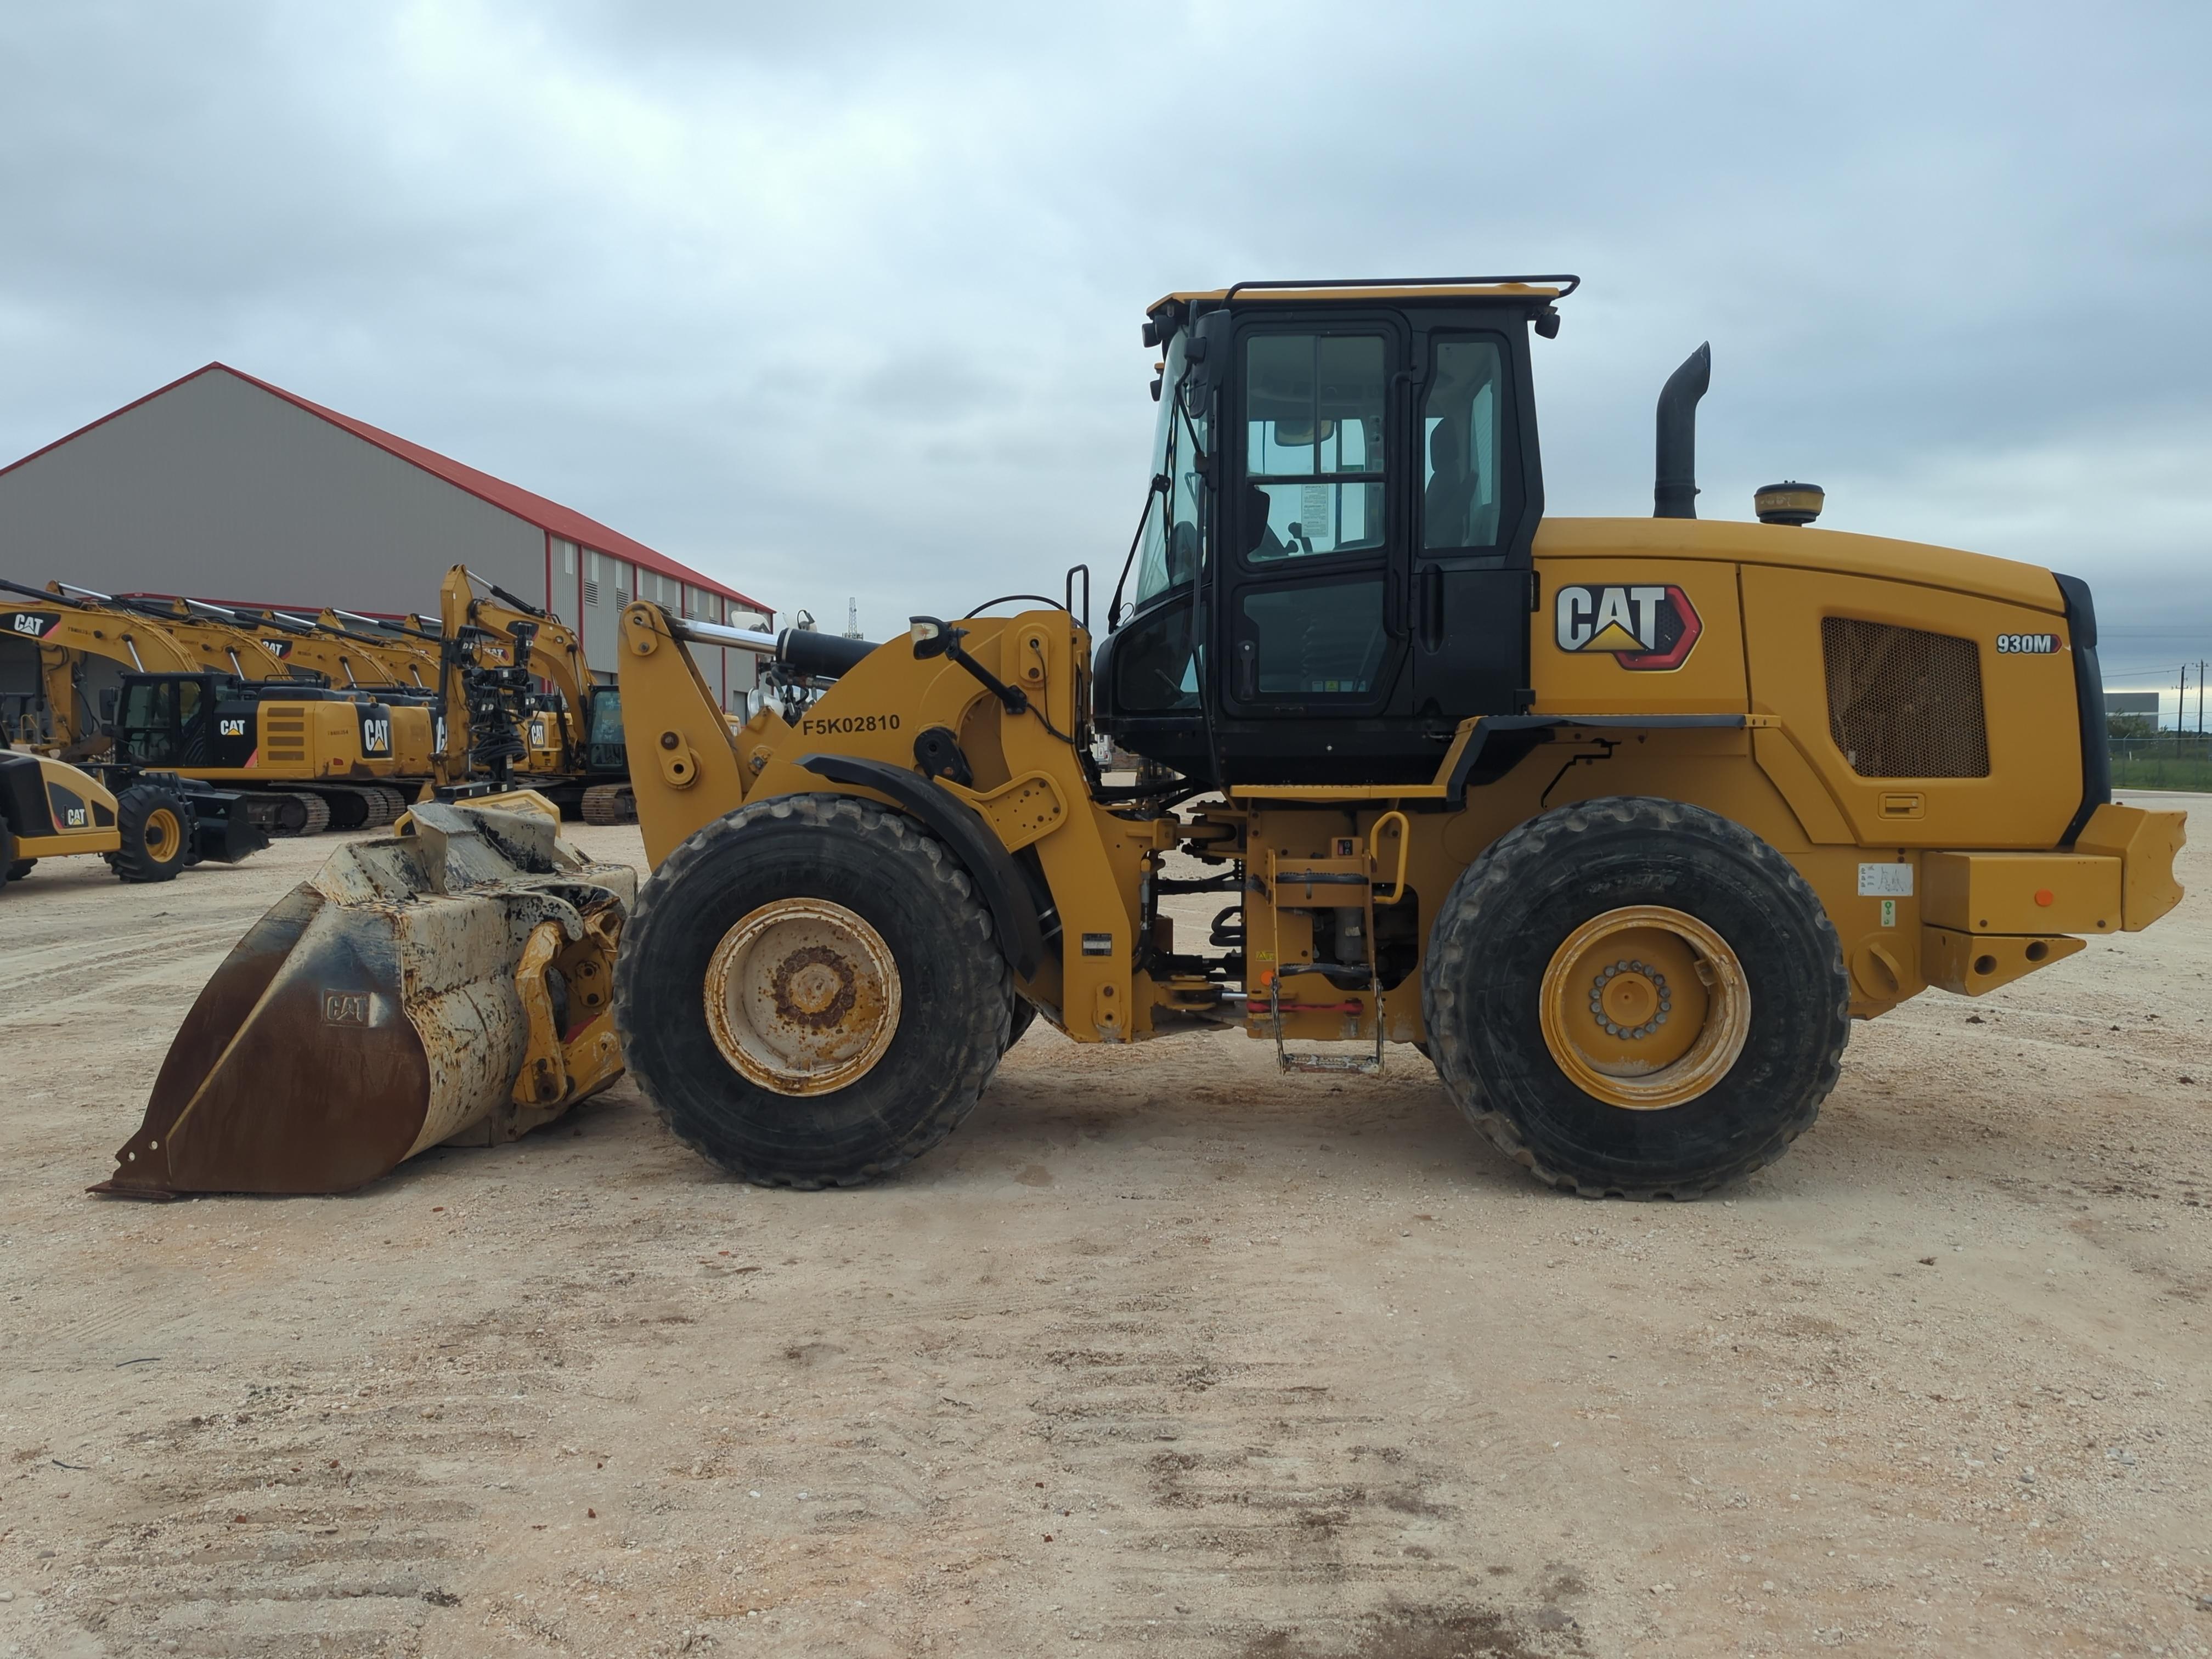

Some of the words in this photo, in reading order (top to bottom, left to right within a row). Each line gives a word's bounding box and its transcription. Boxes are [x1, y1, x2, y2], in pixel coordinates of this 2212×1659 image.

[14, 613, 44, 636] CAT
[1558, 586, 1664, 651] CAT
[1997, 635, 2051, 653] 930M
[220, 719, 245, 735] CAT
[364, 719, 388, 751] CAT
[531, 725, 544, 744] CAT
[803, 714, 900, 736] F5K02810
[67, 809, 85, 825] CAT
[327, 996, 367, 1022] CAT
